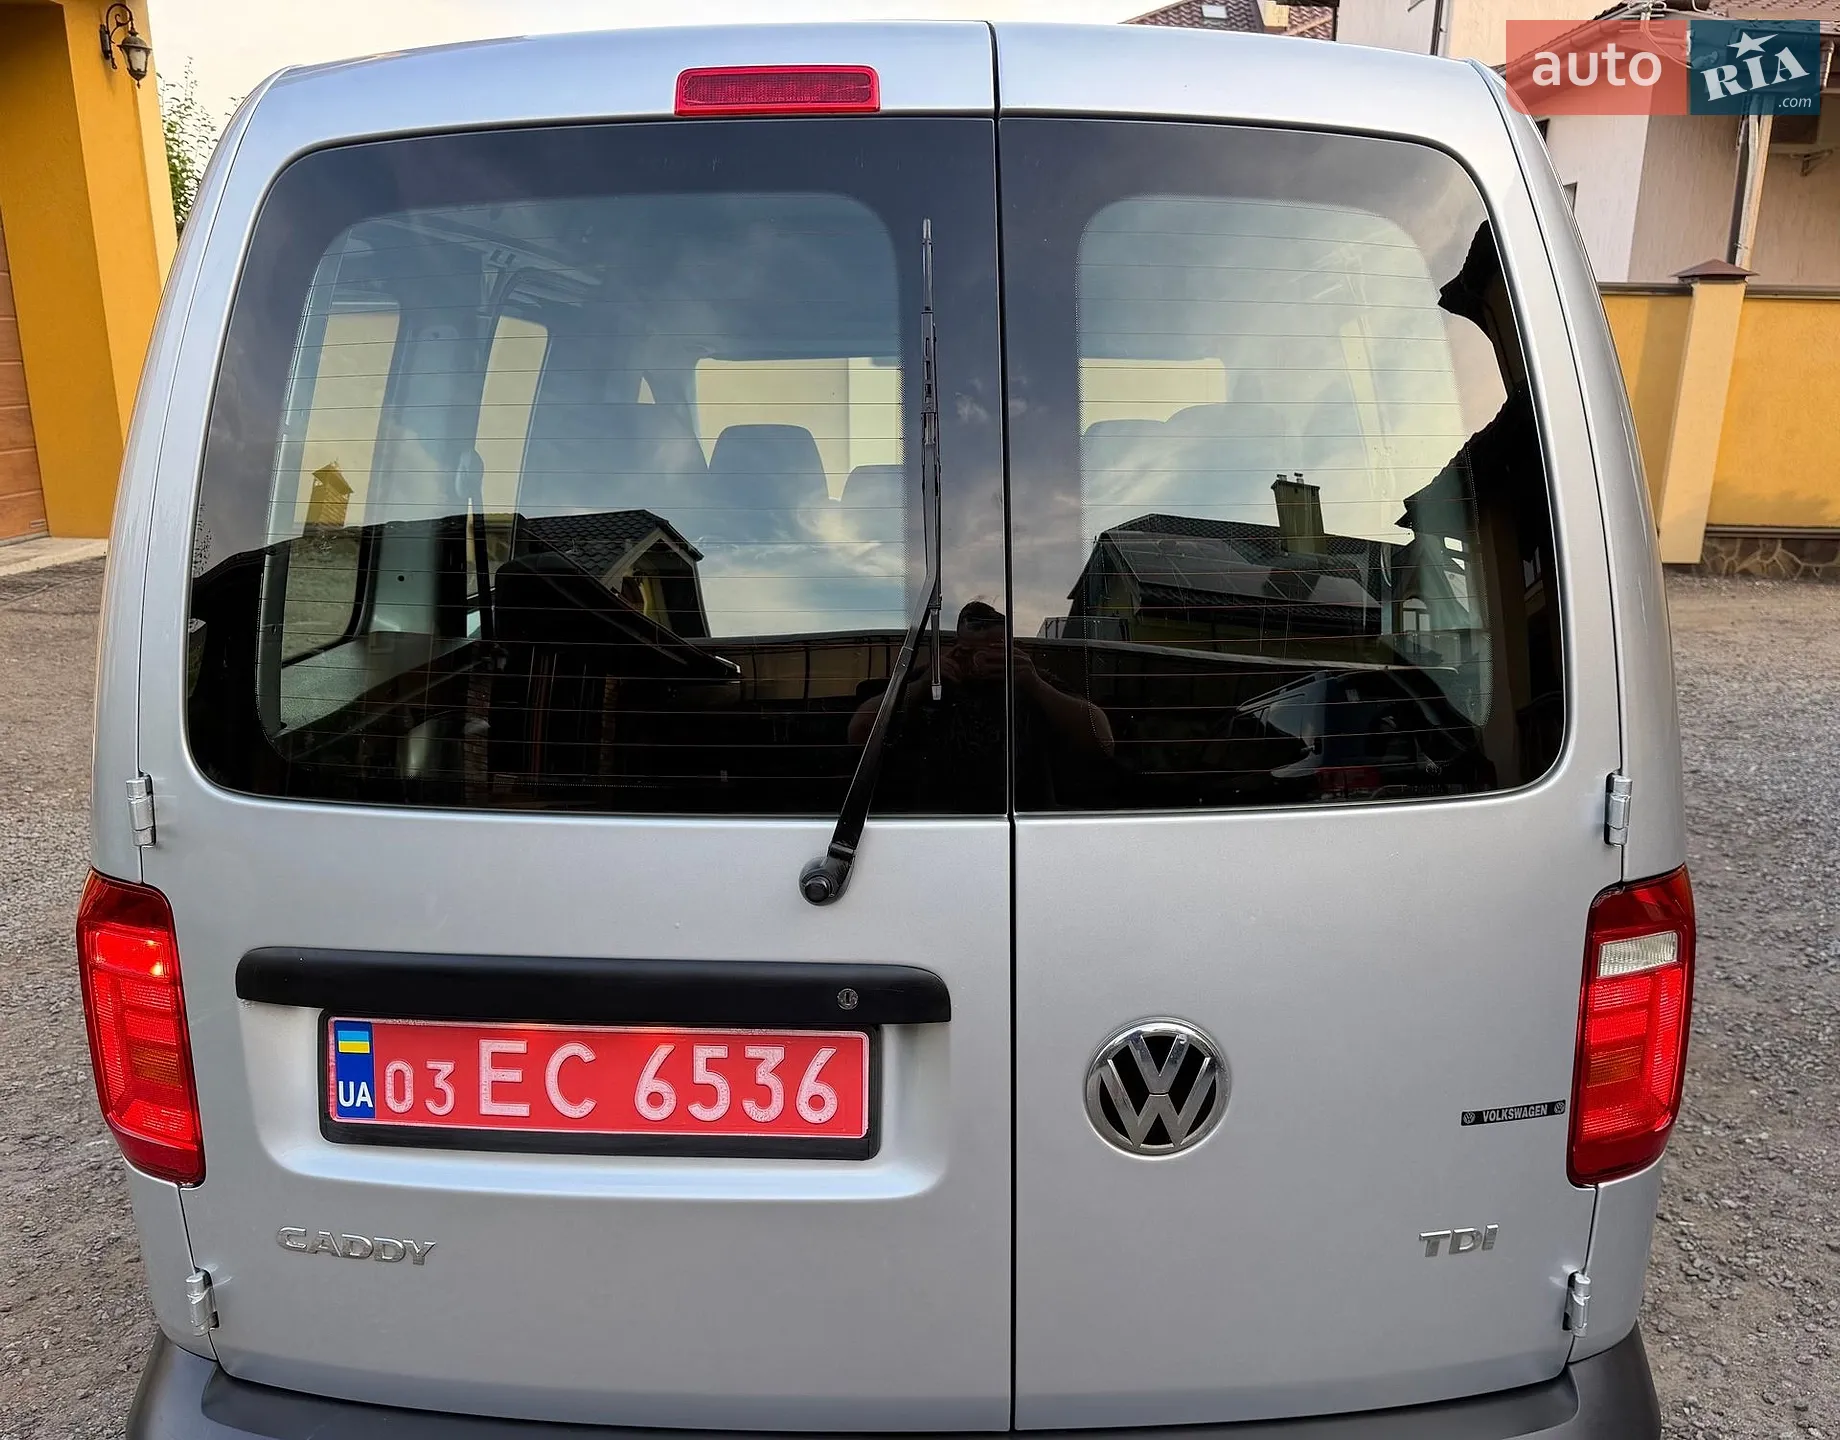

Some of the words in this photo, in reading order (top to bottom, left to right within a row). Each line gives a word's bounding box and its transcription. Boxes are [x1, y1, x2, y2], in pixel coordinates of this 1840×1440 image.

[338, 1081, 373, 1108] UA
[384, 1061, 455, 1117] 03
[478, 1039, 598, 1118] EC
[634, 1045, 839, 1125] 6536
[1482, 1104, 1548, 1123] VOLKSWAGEN
[276, 1225, 437, 1266] CADDY
[1419, 1223, 1499, 1258] TDI
